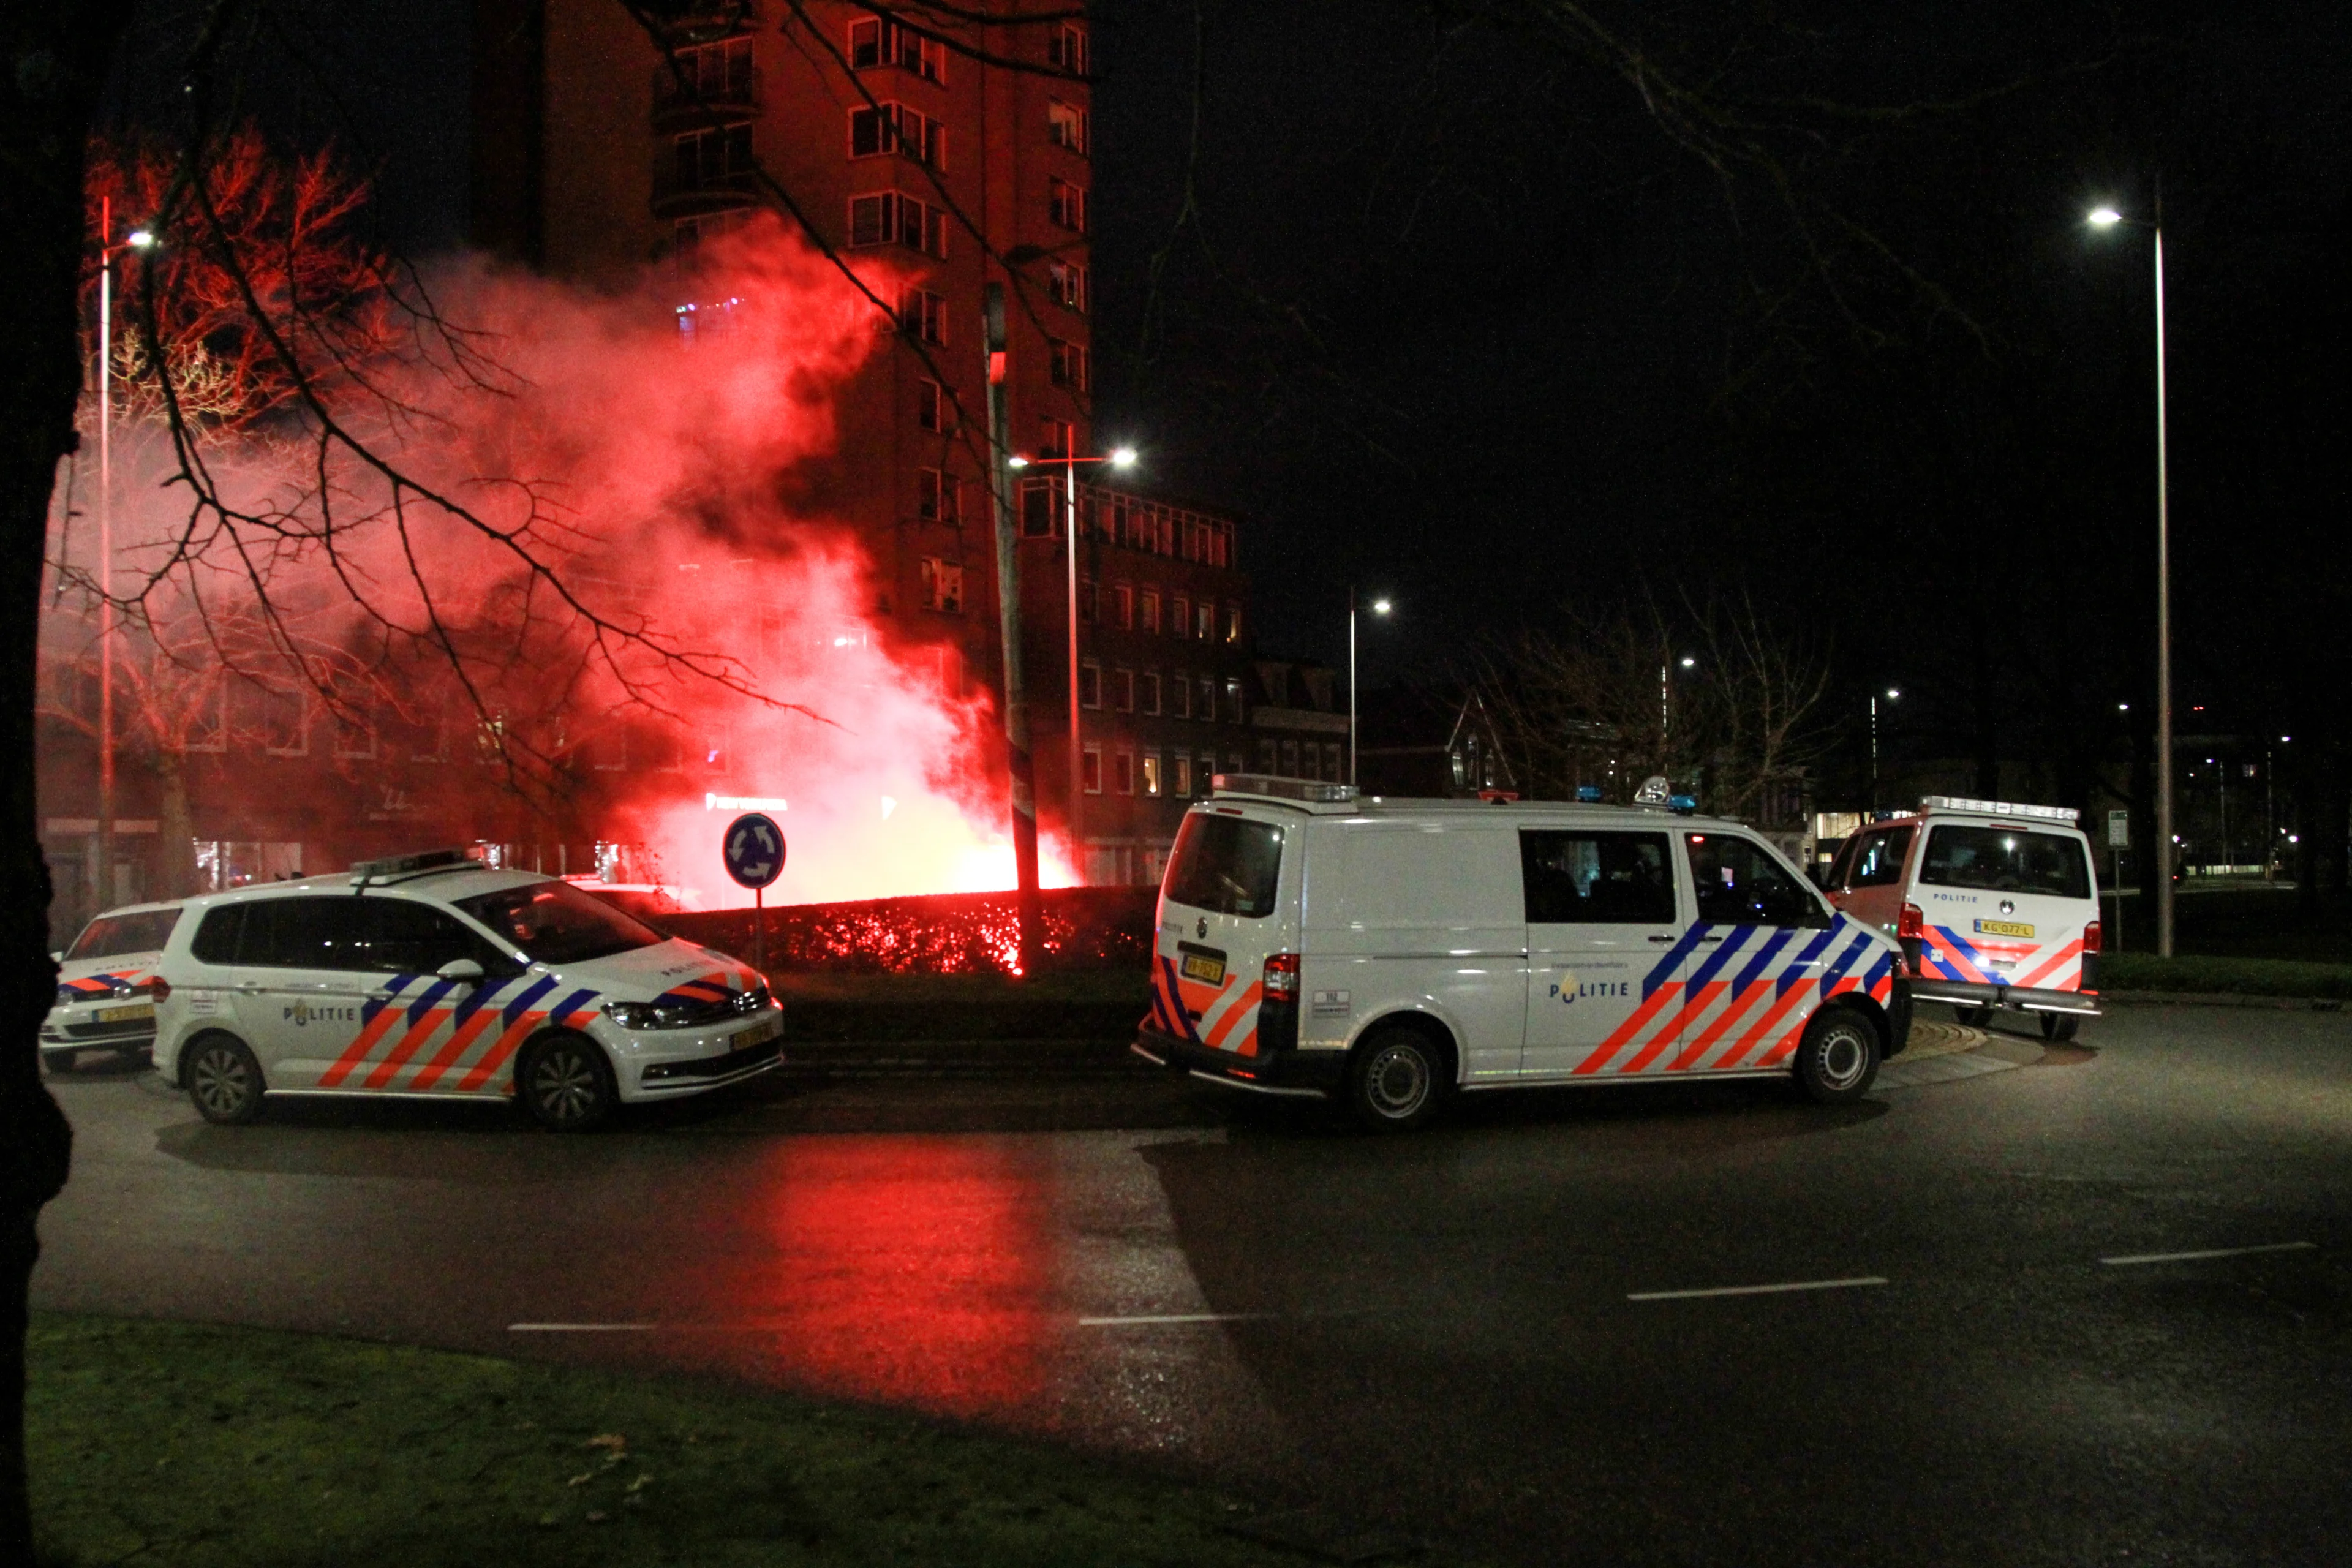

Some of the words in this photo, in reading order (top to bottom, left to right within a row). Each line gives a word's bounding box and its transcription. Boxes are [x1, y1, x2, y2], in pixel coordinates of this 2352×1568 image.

[1933, 894, 1978, 903] POLITIE
[1550, 982, 1628, 1004] POLITIE
[284, 1007, 355, 1026] POLITIE
